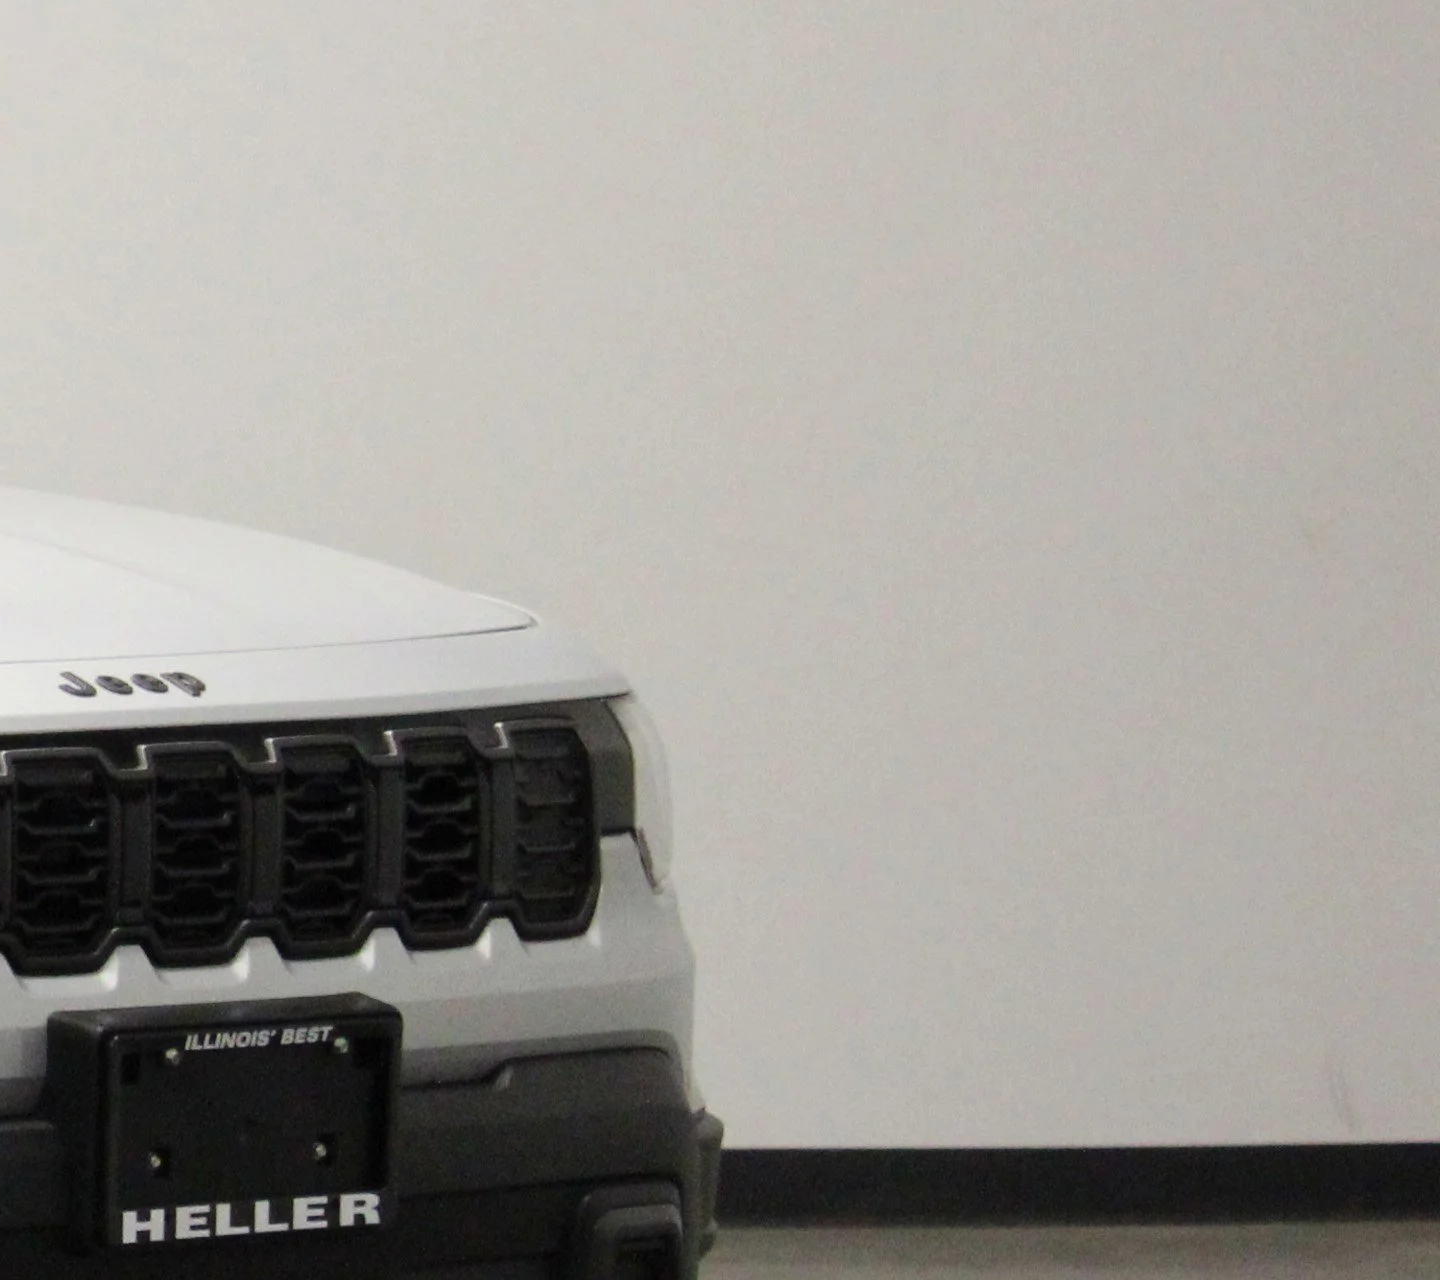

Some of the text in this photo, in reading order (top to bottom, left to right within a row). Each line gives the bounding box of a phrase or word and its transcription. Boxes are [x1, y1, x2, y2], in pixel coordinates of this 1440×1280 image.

[58, 671, 206, 698] Jeep
[281, 1025, 334, 1045] BEST
[121, 1192, 381, 1245] HELLER
